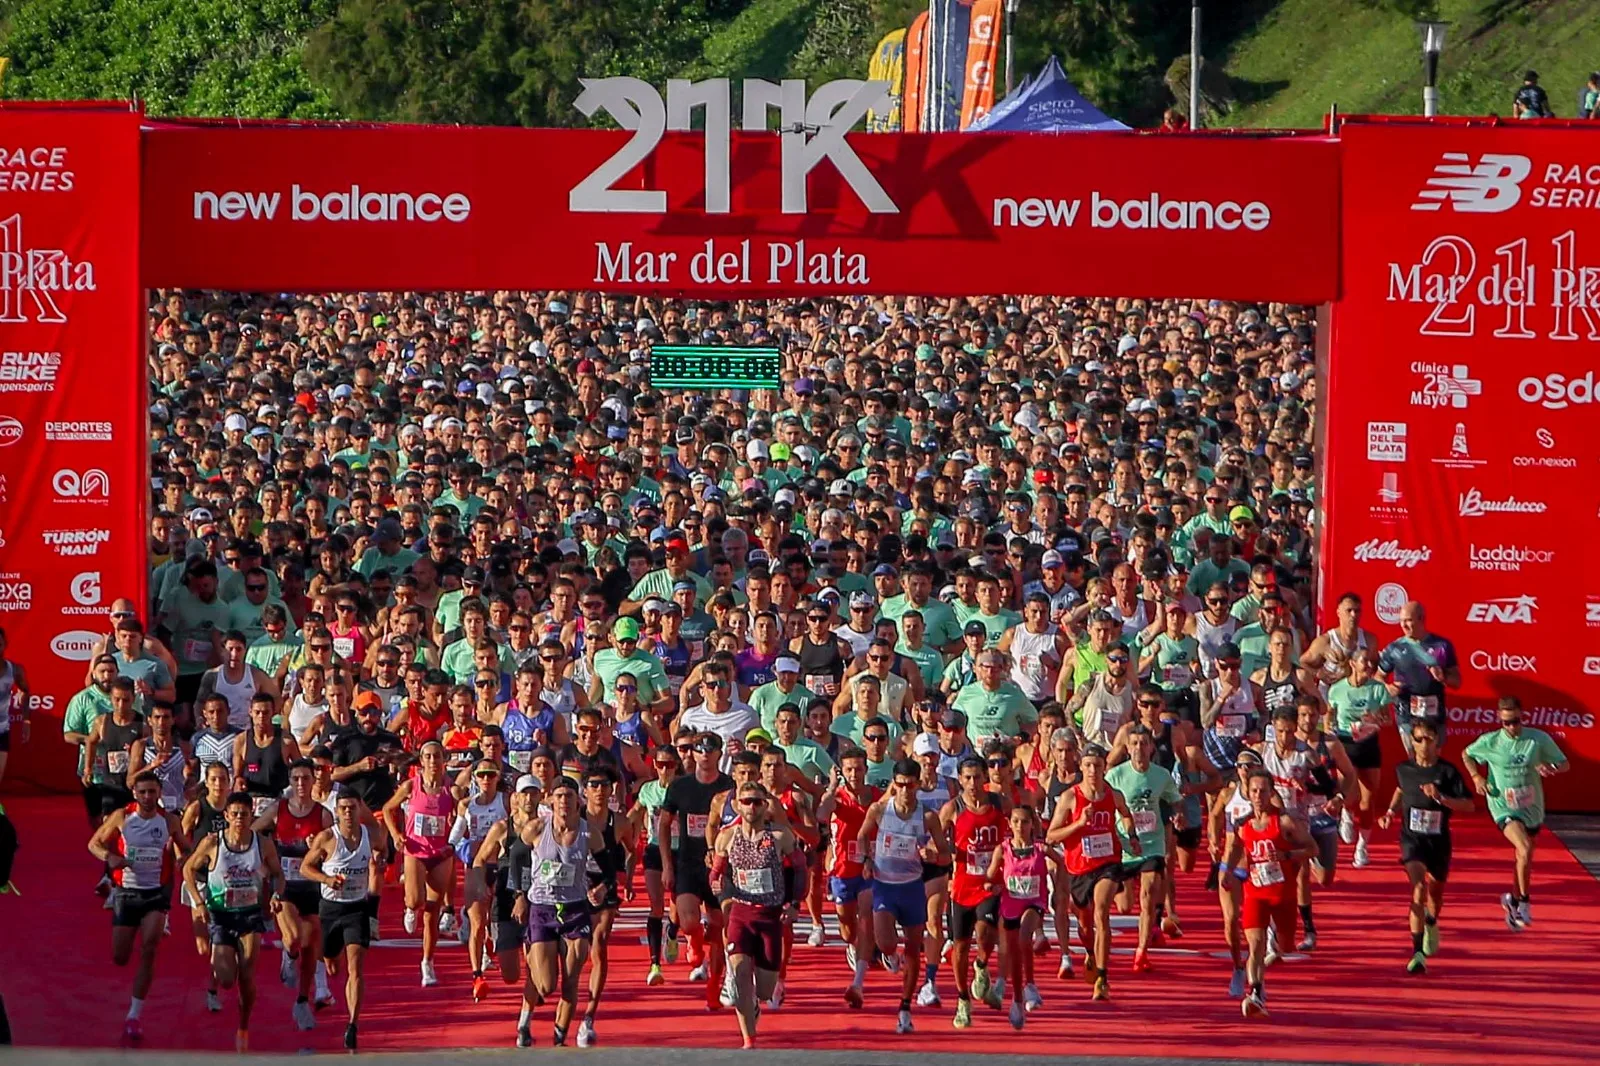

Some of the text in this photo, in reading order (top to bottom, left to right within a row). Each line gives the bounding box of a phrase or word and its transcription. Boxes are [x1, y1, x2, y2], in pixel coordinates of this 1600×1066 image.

[0, 171, 74, 191] ERIES
[1544, 163, 1600, 185] RAC
[193, 184, 471, 222] new balance
[1530, 187, 1600, 208] SERI
[992, 191, 1271, 230] new balance
[594, 239, 870, 285] Mar del Plata
[1386, 262, 1465, 303] Mar
[1477, 263, 1535, 306] del
[0, 365, 58, 380] BIKE
[1423, 373, 1449, 396] 25
[1410, 391, 1448, 409] Mayo
[45, 422, 112, 432] DEPORTES
[1370, 425, 1395, 433] MAR
[1370, 444, 1403, 453] PLATA
[1459, 487, 1547, 516] Bauducco
[42, 528, 110, 545] TURRÓN
[60, 541, 98, 556] MANÍ
[1354, 538, 1432, 567] Kellogg's
[1469, 543, 1555, 563] Laddubar
[1470, 561, 1520, 571] PROTEIN
[1466, 594, 1539, 624] ENA
[56, 640, 96, 651] Grani
[1470, 650, 1537, 673] Cutex
[450, 752, 475, 763] FILA
